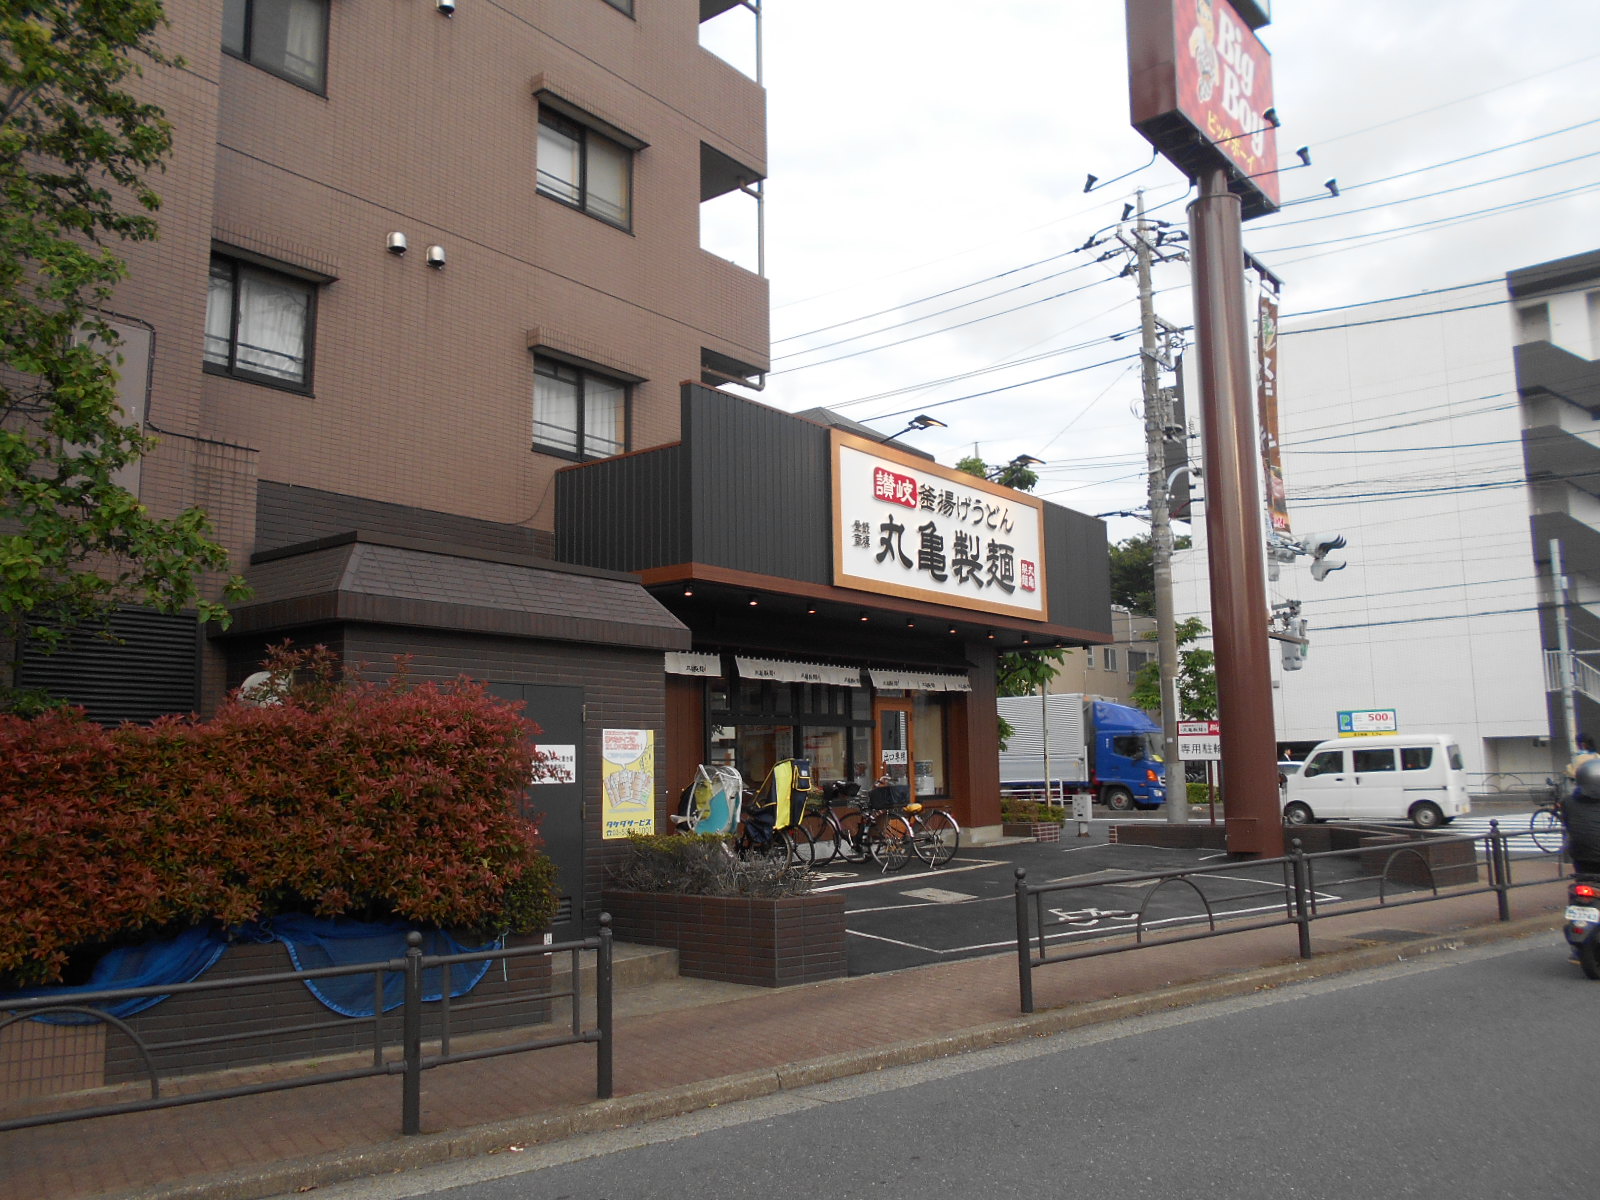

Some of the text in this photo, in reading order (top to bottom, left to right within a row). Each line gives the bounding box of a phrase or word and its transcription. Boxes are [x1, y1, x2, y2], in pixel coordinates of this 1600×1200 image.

[1217, 8, 1255, 97] Big
[1222, 63, 1265, 158] Boy
[875, 470, 916, 506] 讃岐
[875, 513, 1017, 595] 丸亀製麺
[1368, 713, 1389, 722] 500
